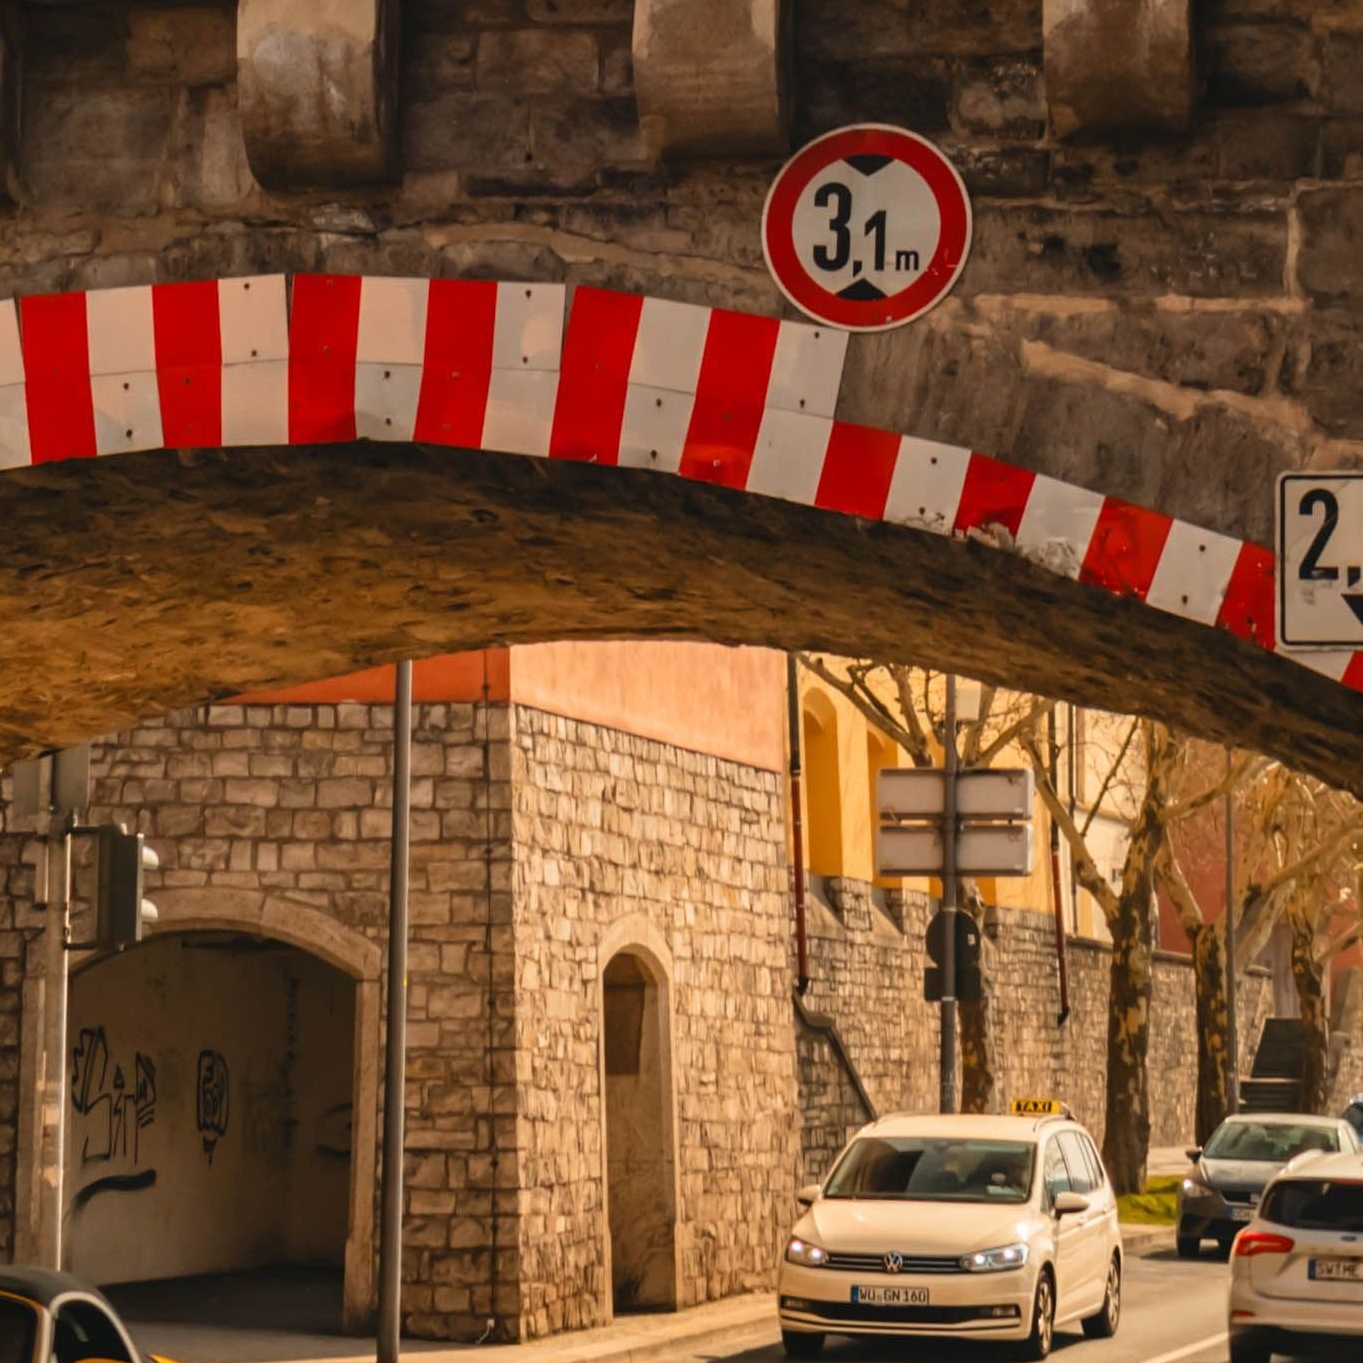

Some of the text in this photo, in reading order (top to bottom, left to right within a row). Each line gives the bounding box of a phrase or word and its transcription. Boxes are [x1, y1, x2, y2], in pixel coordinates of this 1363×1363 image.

[812, 181, 919, 278] 3,1 m
[1017, 1101, 1050, 1113] TAXI
[904, 1290, 926, 1303] 160
